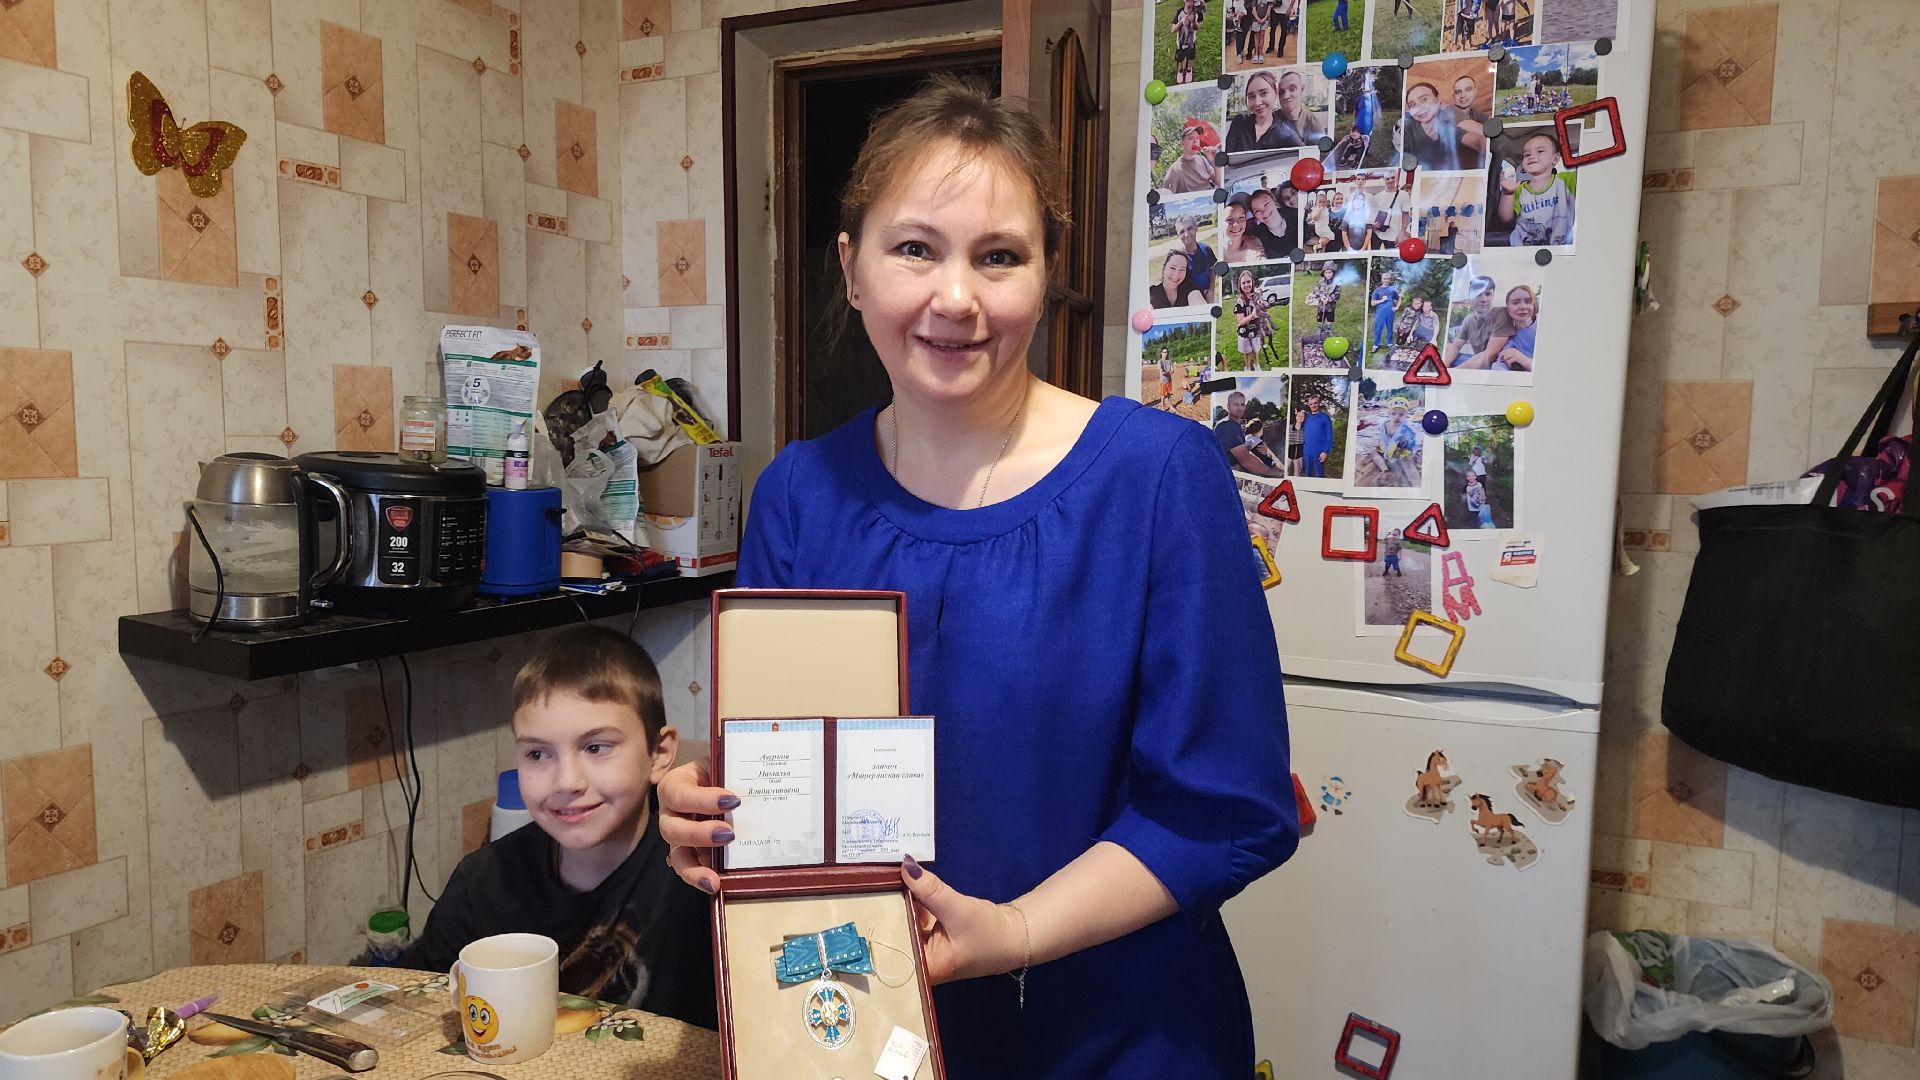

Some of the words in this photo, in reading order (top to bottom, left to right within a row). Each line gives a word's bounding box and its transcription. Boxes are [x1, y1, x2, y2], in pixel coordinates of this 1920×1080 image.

[445, 329, 472, 338] PERFECT
[473, 330, 483, 339] FIT
[473, 378, 482, 388] 5
[708, 447, 734, 458] Tefal
[390, 536, 408, 547] 200
[391, 562, 404, 573] 32
